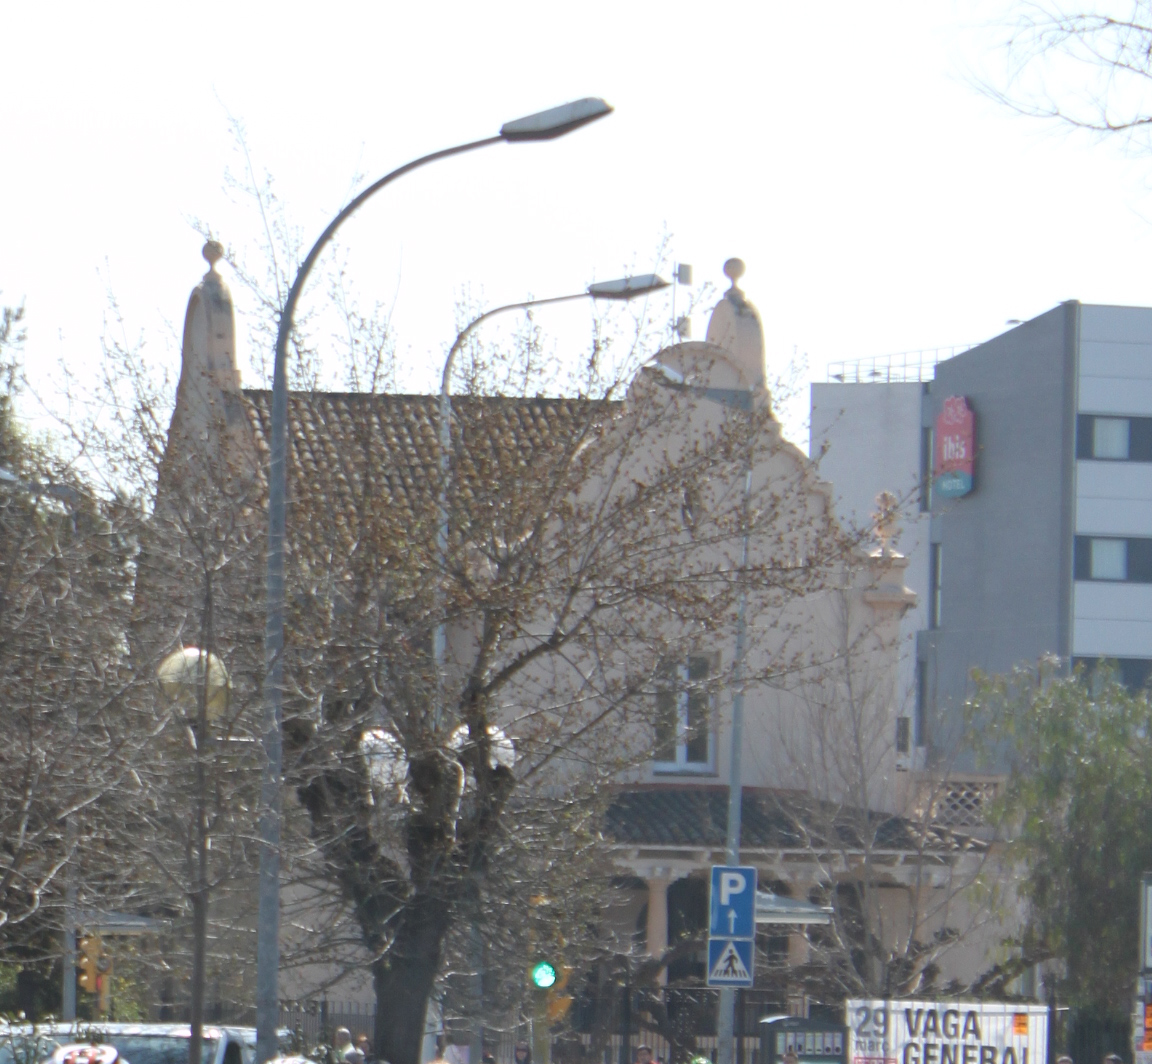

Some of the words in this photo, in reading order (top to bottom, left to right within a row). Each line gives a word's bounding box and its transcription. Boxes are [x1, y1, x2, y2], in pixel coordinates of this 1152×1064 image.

[943, 435, 965, 460] ibis
[720, 872, 747, 906] P
[855, 1006, 888, 1038] 29
[905, 1008, 981, 1040] VAGA
